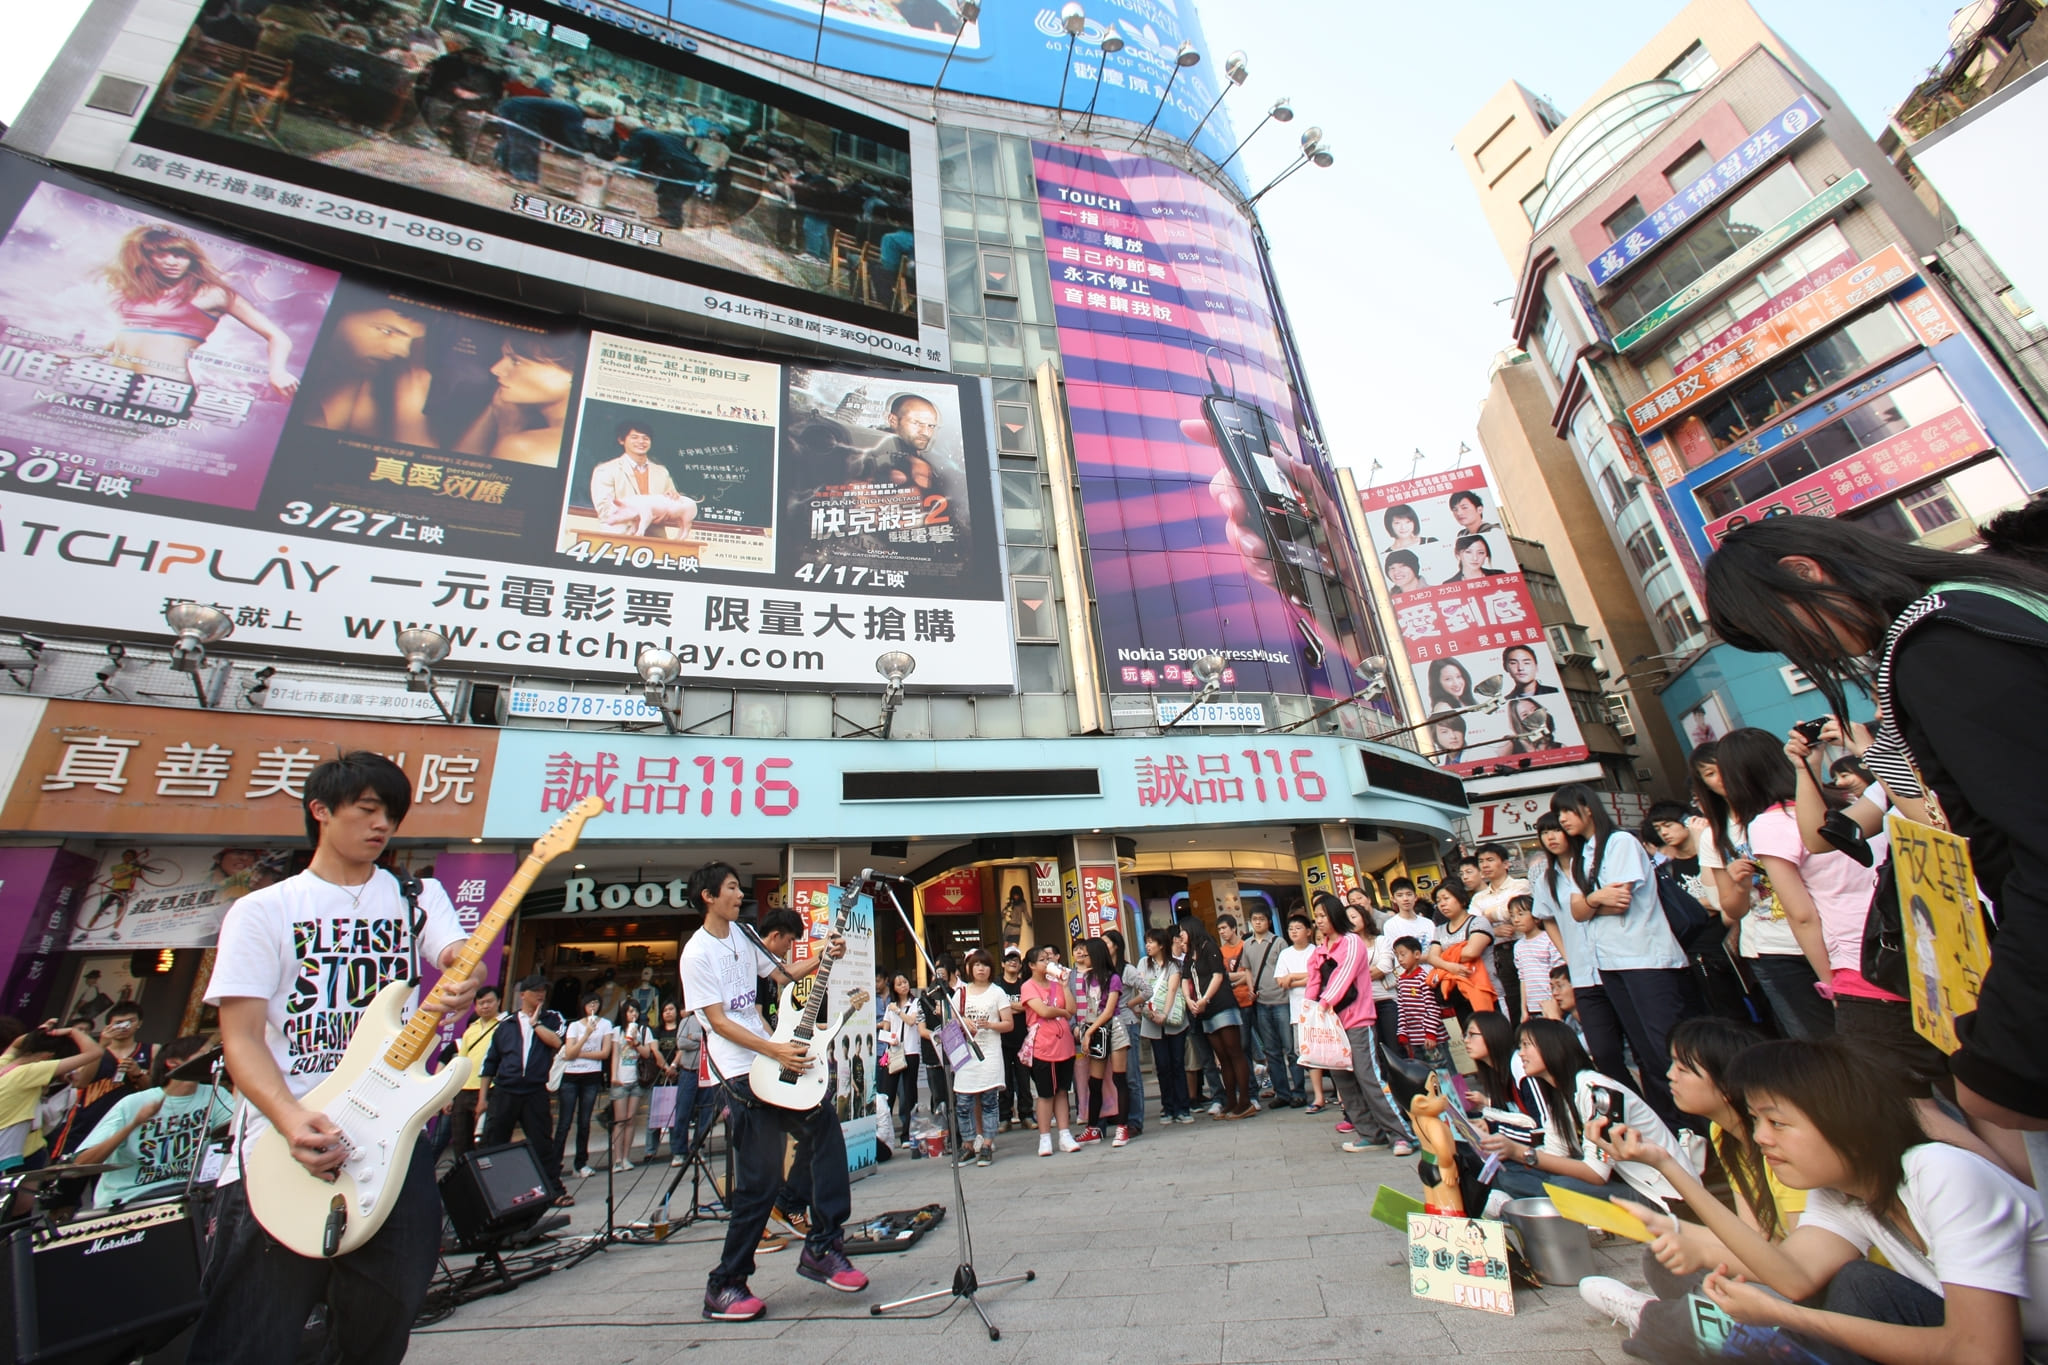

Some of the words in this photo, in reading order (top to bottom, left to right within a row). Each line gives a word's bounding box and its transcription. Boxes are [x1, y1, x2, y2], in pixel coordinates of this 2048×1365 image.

[1687, 128, 1781, 205] 補習班
[1057, 187, 1122, 212] TOUCH
[510, 192, 664, 248] 這份清單
[1061, 246, 1167, 281] 自己的節奏
[1063, 266, 1151, 296] 永不停止
[1063, 287, 1173, 323] 音樂讓我說
[599, 358, 632, 371] School
[633, 364, 657, 377] days
[659, 369, 681, 380] with
[691, 376, 707, 385] pig
[33, 390, 98, 412] MAKE
[100, 402, 122, 415] IT
[122, 407, 202, 432] HAPPEN
[368, 456, 513, 505] 真愛效應
[278, 501, 445, 545] 3/27上映
[565, 540, 700, 574] 4/10上映
[794, 562, 906, 589] 4/17上映
[371, 571, 674, 627] 一元電影票
[705, 595, 957, 643] 限量大搶購
[1409, 590, 1433, 602] 九把刀
[1438, 584, 1462, 596] 方文山
[1397, 588, 1527, 642] 愛到底
[1118, 648, 1165, 662] Nokia
[1168, 648, 1208, 662] 5800
[1191, 704, 1262, 722] 8787-5869
[41, 735, 480, 805] 真善美院
[540, 751, 800, 818] 誠品116
[1134, 748, 1328, 808] 誠品116
[1065, 880, 1079, 900] 5F
[1307, 866, 1328, 885] 5F
[1416, 874, 1440, 891] 5F
[291, 917, 410, 959] PLEASE
[1069, 918, 1081, 936] 39
[285, 955, 410, 1015] STOP
[138, 1105, 213, 1140] PLEASE
[84, 1230, 147, 1256] Marshall
[1409, 1216, 1450, 1243] DM
[1453, 1283, 1512, 1313] FUN4
